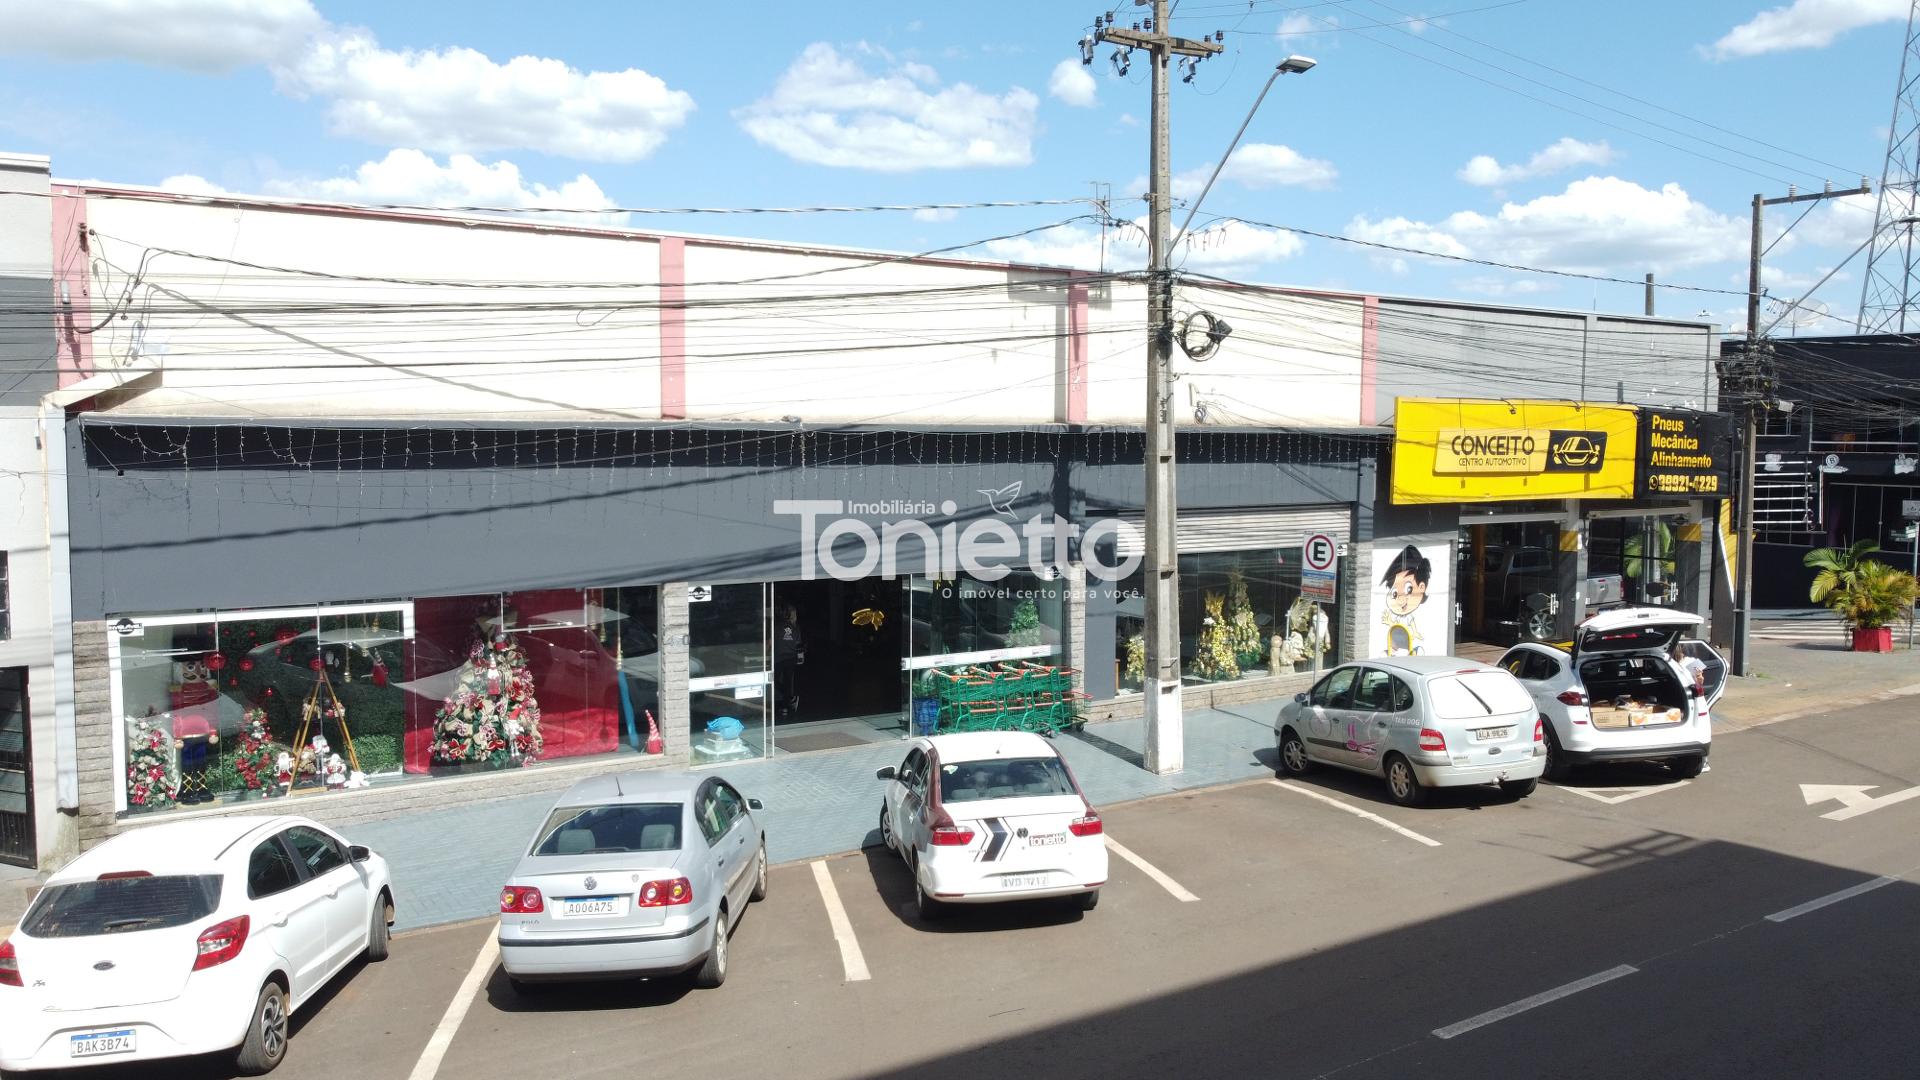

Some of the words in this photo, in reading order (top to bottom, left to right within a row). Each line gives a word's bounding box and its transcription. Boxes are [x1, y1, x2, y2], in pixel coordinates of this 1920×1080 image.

[1652, 415, 1684, 432] Pneus
[1452, 435, 1535, 455] CONCEITO
[1651, 433, 1698, 450] Mecânica
[1459, 457, 1484, 467] CENTRO
[1486, 457, 1527, 467] AUTOMOTIVO
[1651, 451, 1712, 468] Alinhamento
[1313, 541, 1327, 562] E
[77, 1037, 129, 1053] BAK3B74
